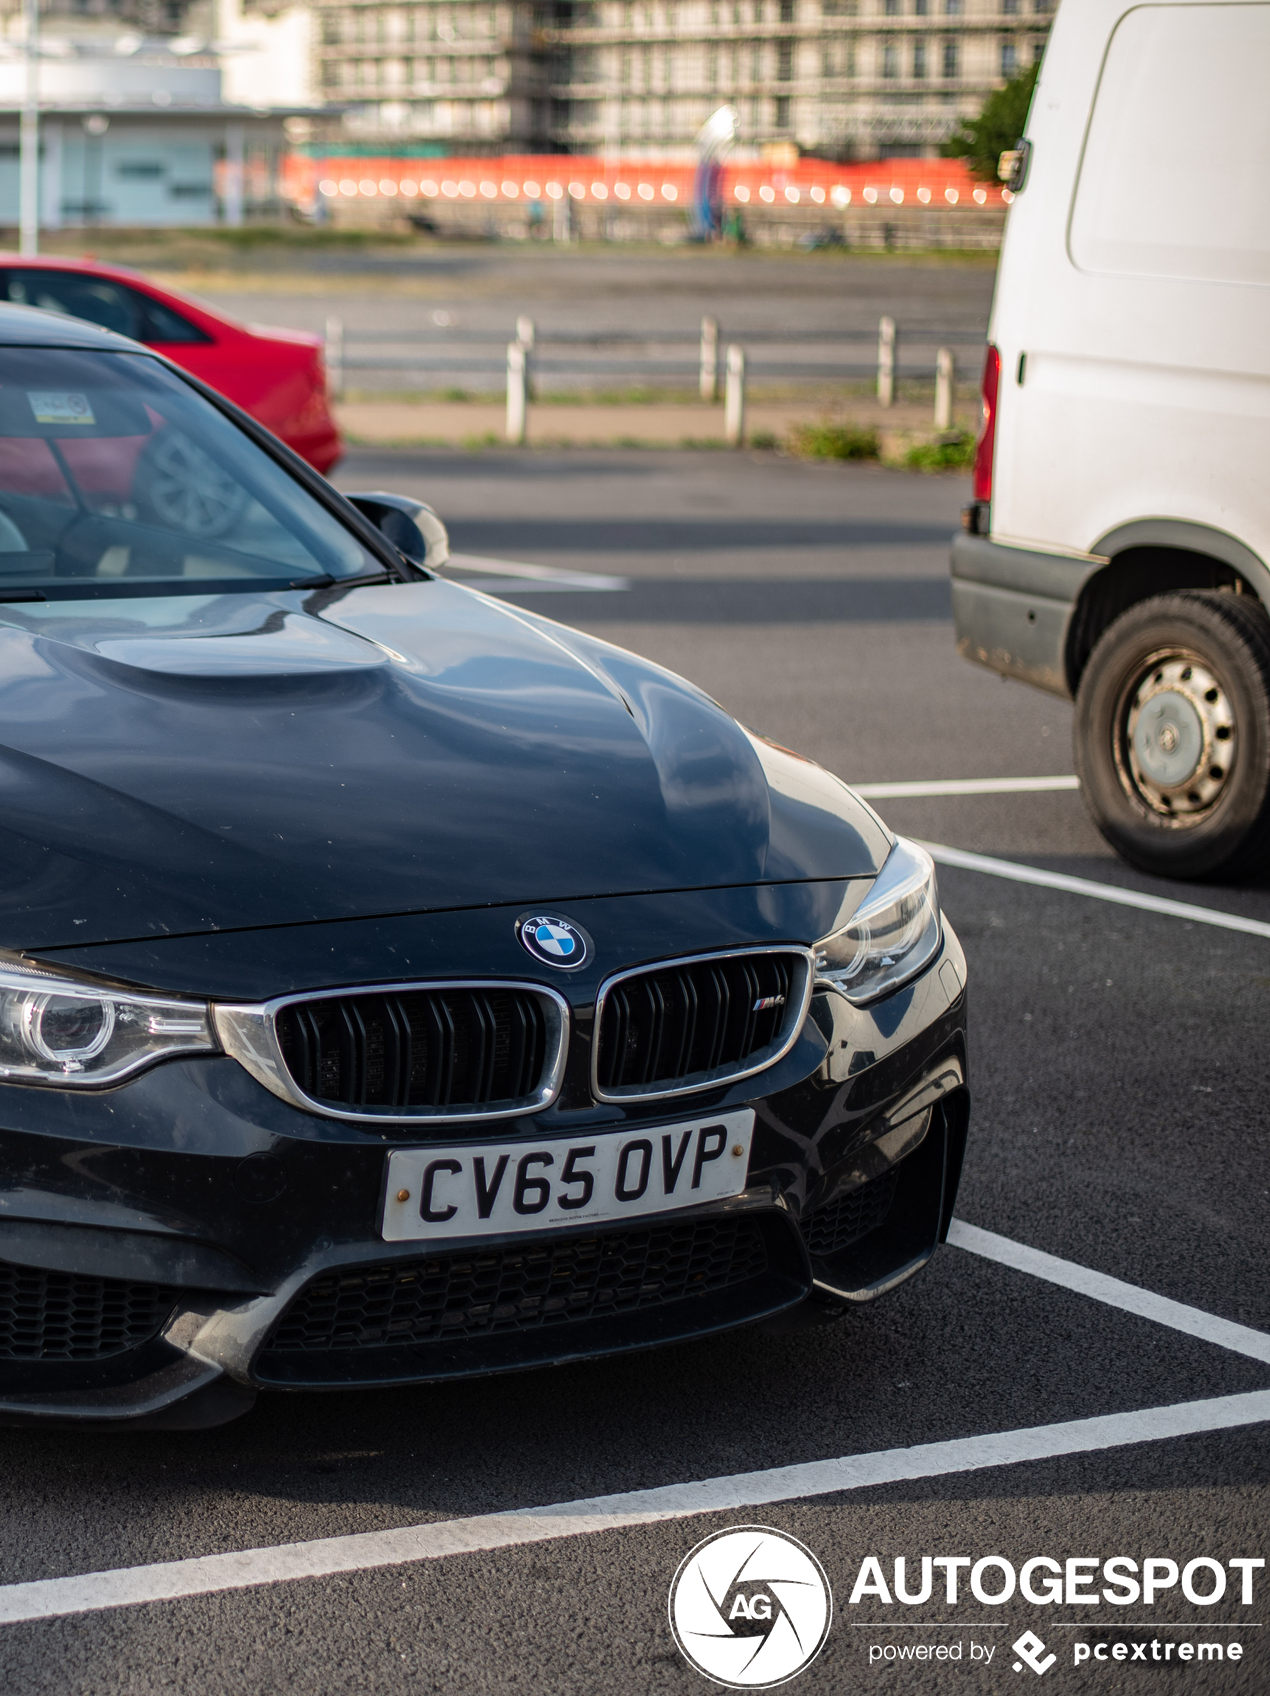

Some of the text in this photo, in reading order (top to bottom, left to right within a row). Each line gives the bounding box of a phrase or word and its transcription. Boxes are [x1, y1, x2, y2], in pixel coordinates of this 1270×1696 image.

[524, 917, 571, 934] BMW
[419, 1124, 727, 1222] CV65 OVP
